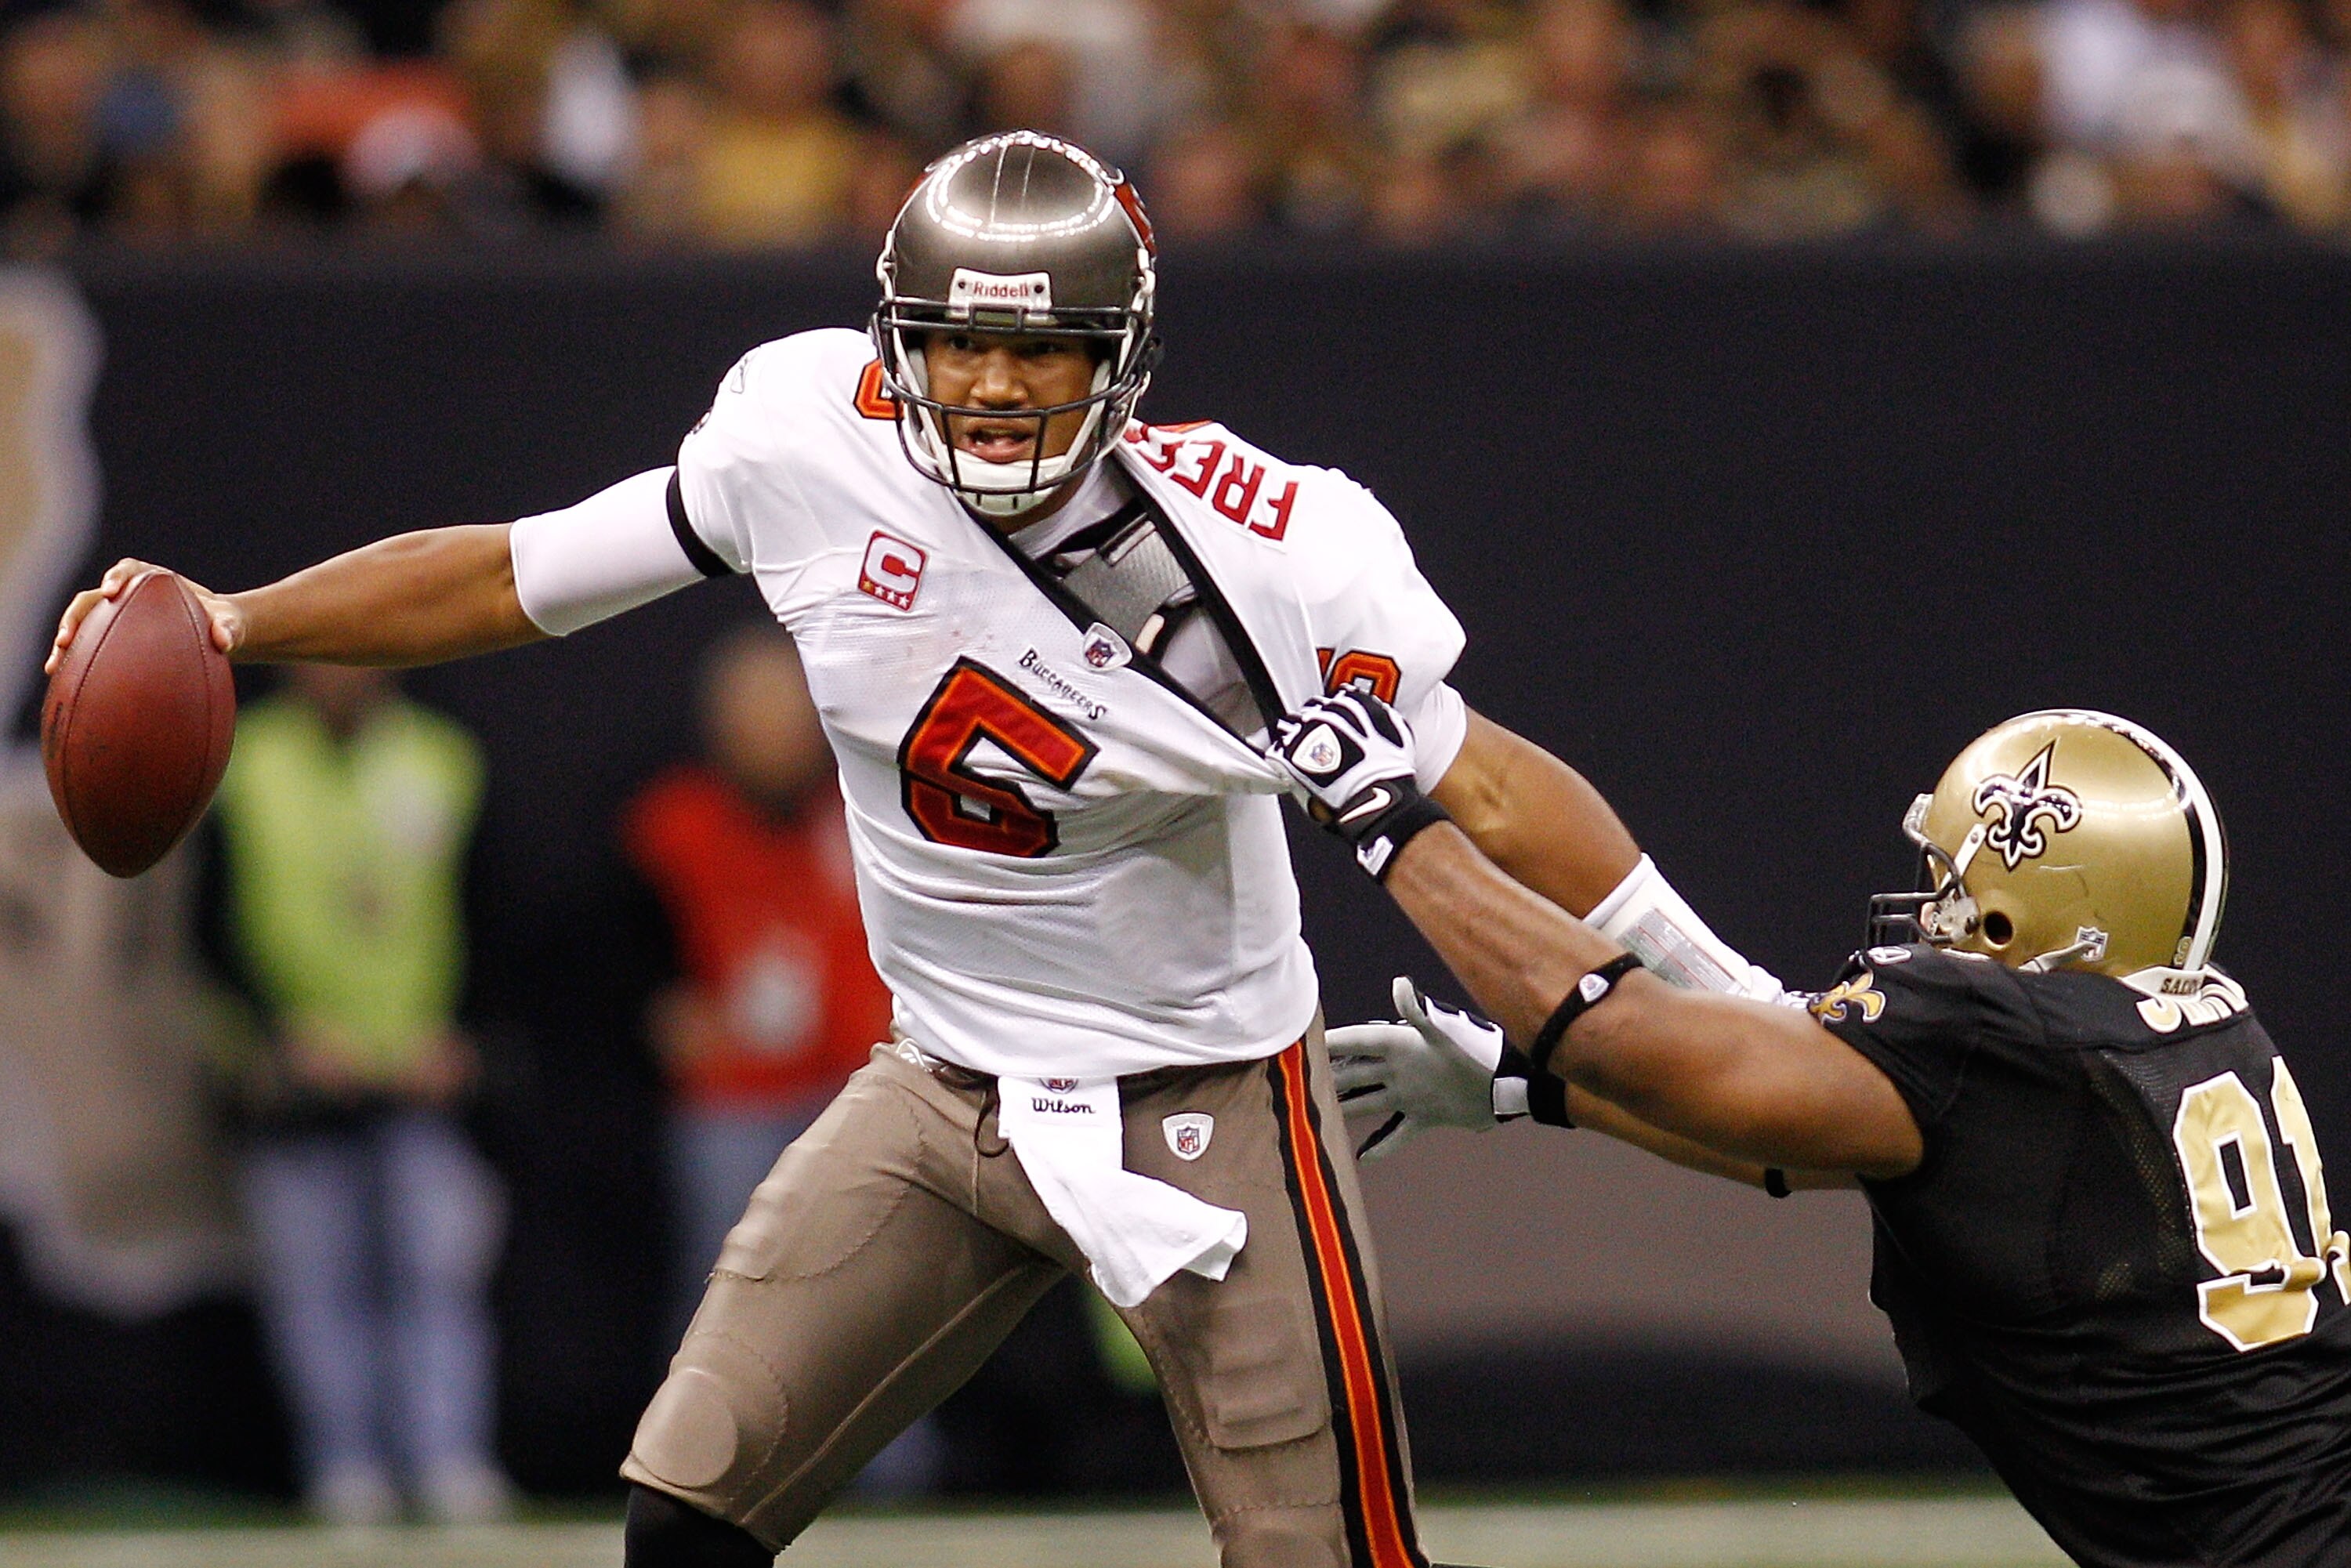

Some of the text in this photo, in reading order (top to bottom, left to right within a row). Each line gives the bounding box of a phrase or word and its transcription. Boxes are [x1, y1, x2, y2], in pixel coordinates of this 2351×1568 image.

[973, 281, 1028, 297] Riddell
[864, 537, 922, 593] C
[1031, 1097, 1096, 1114] Wilson
